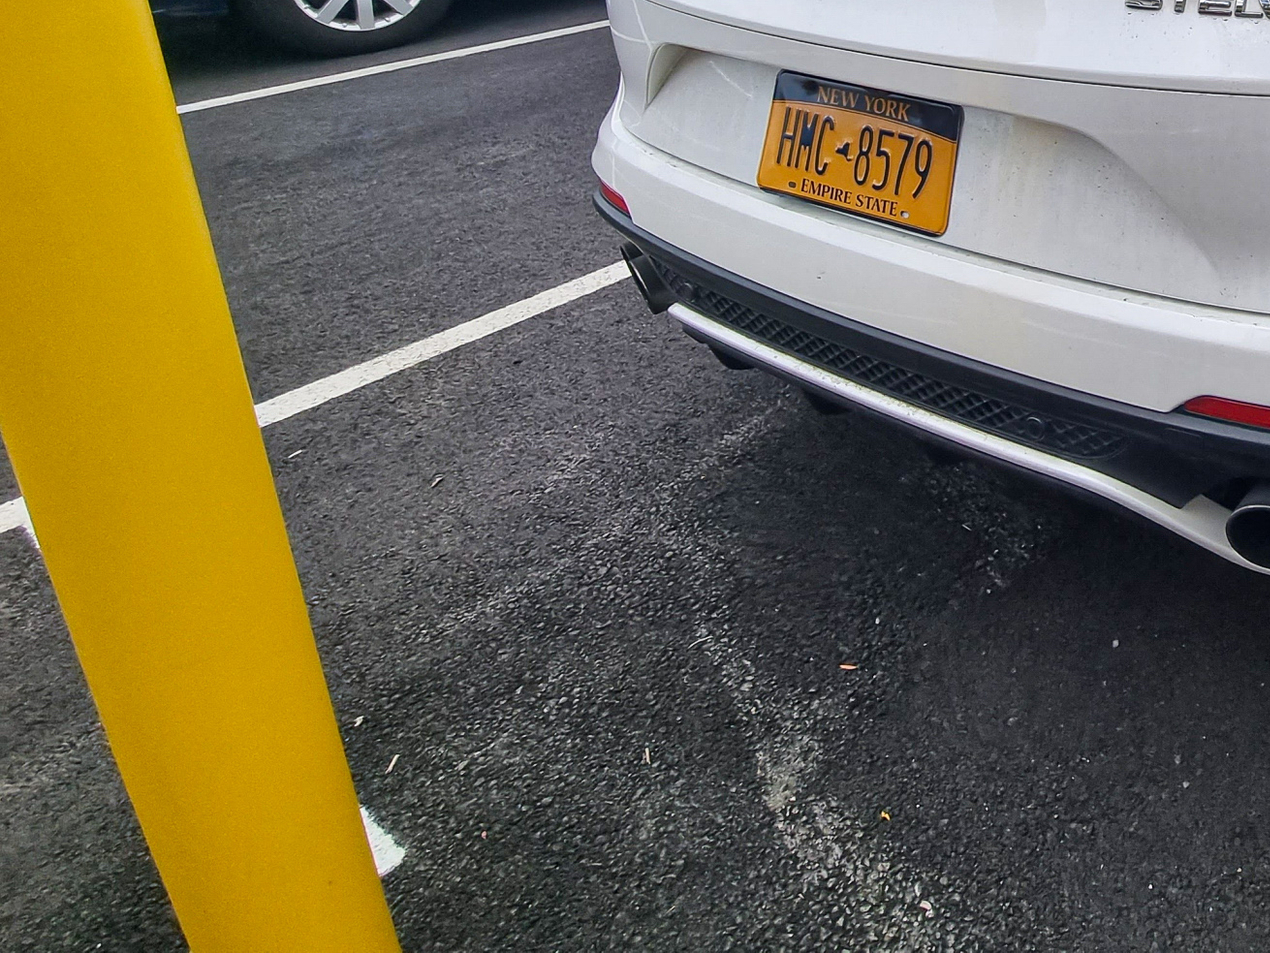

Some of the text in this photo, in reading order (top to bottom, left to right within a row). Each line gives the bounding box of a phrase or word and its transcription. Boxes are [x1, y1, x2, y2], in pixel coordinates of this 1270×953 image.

[816, 85, 912, 122] NEW YORK
[776, 106, 933, 199] HMC 8579
[801, 178, 898, 216] EMPIRE STATE
